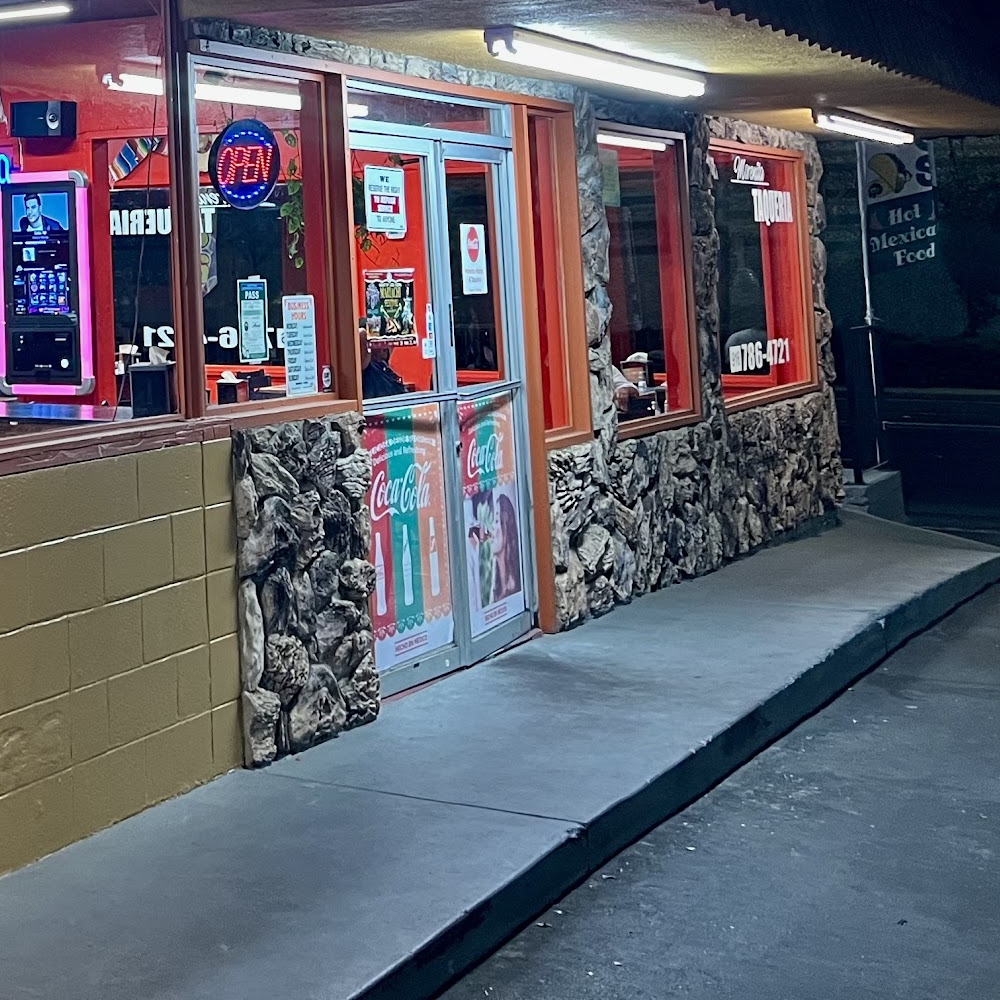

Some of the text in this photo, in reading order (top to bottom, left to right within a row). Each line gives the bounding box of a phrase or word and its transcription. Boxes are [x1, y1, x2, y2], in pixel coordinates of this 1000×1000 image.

[217, 145, 273, 185] OPEN
[379, 175, 390, 183] WE
[751, 188, 794, 227] TAQUERIA
[888, 203, 922, 226] Hot
[893, 242, 936, 267] Food
[244, 290, 260, 300] PASS
[741, 338, 791, 372] 786-4721
[370, 461, 431, 522] Coca-Cola
